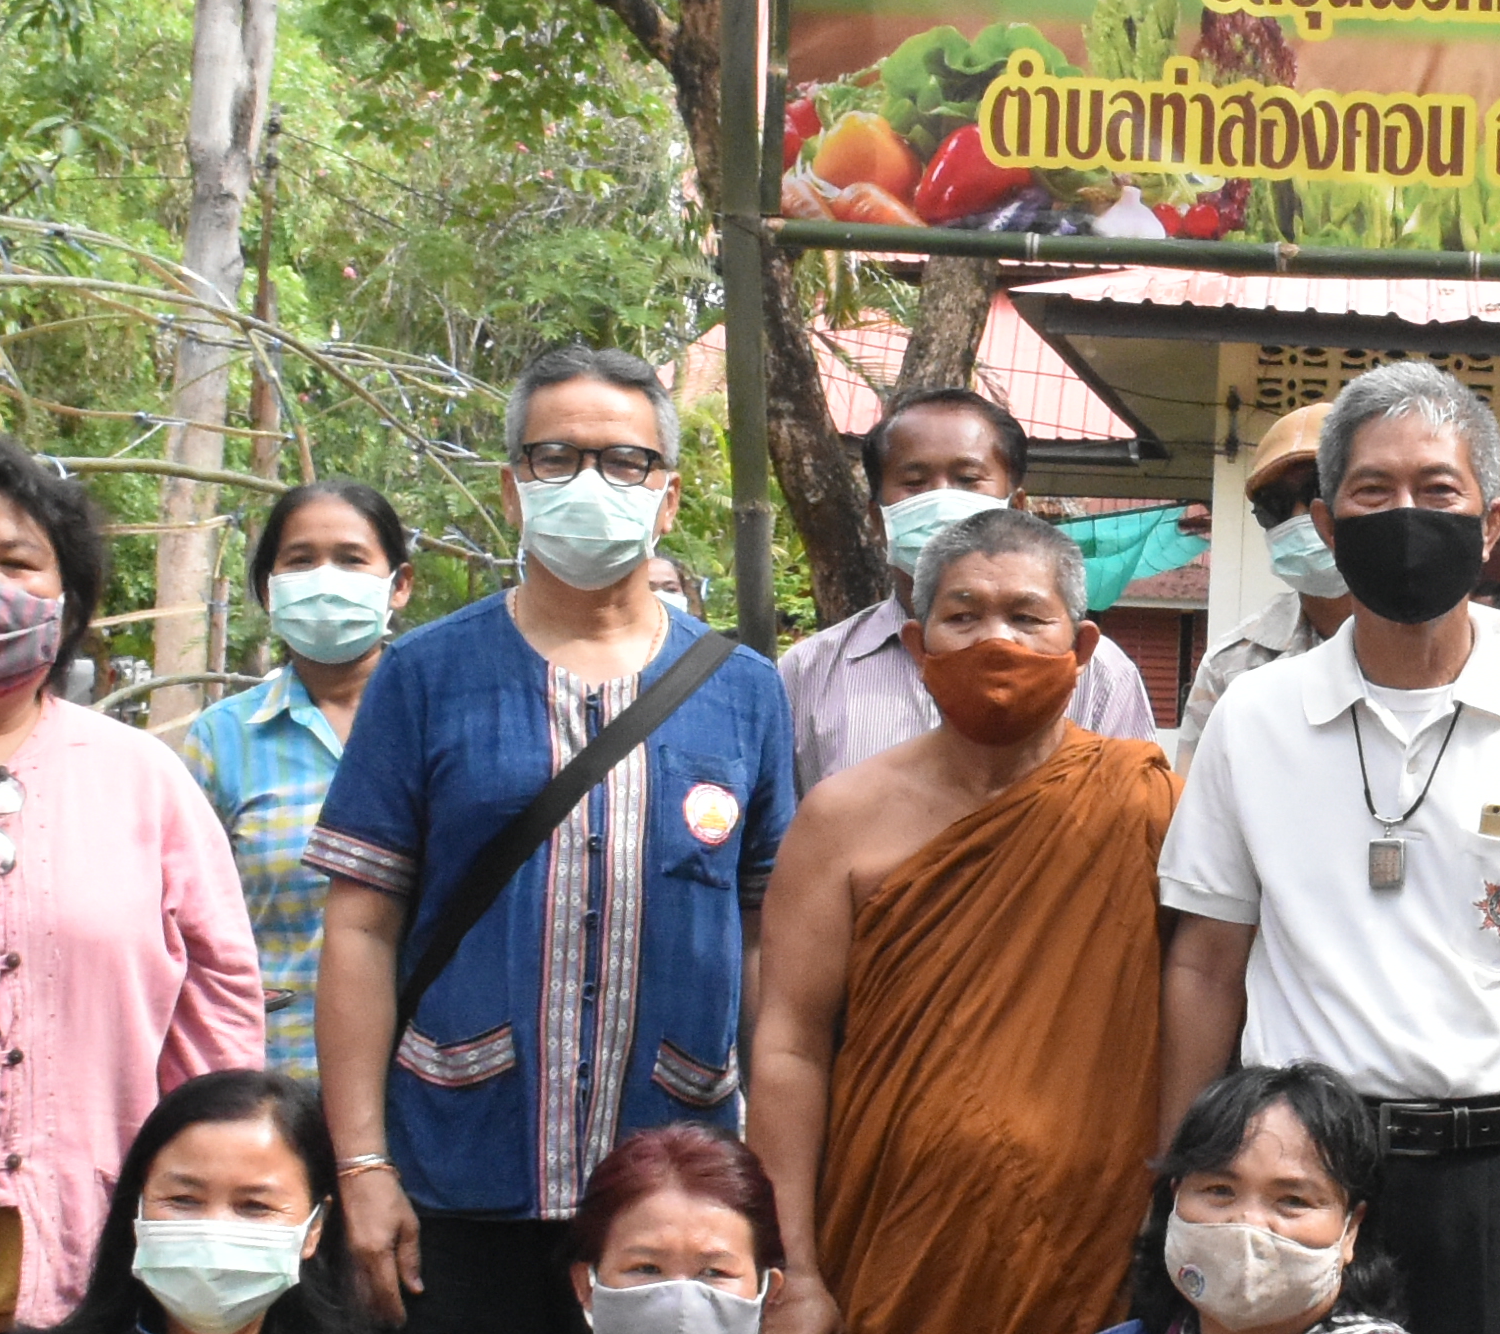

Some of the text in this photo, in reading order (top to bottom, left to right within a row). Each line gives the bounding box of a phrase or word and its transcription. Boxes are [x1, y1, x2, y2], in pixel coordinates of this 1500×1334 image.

[989, 59, 1465, 177] ตำบลท่าสองคอน
